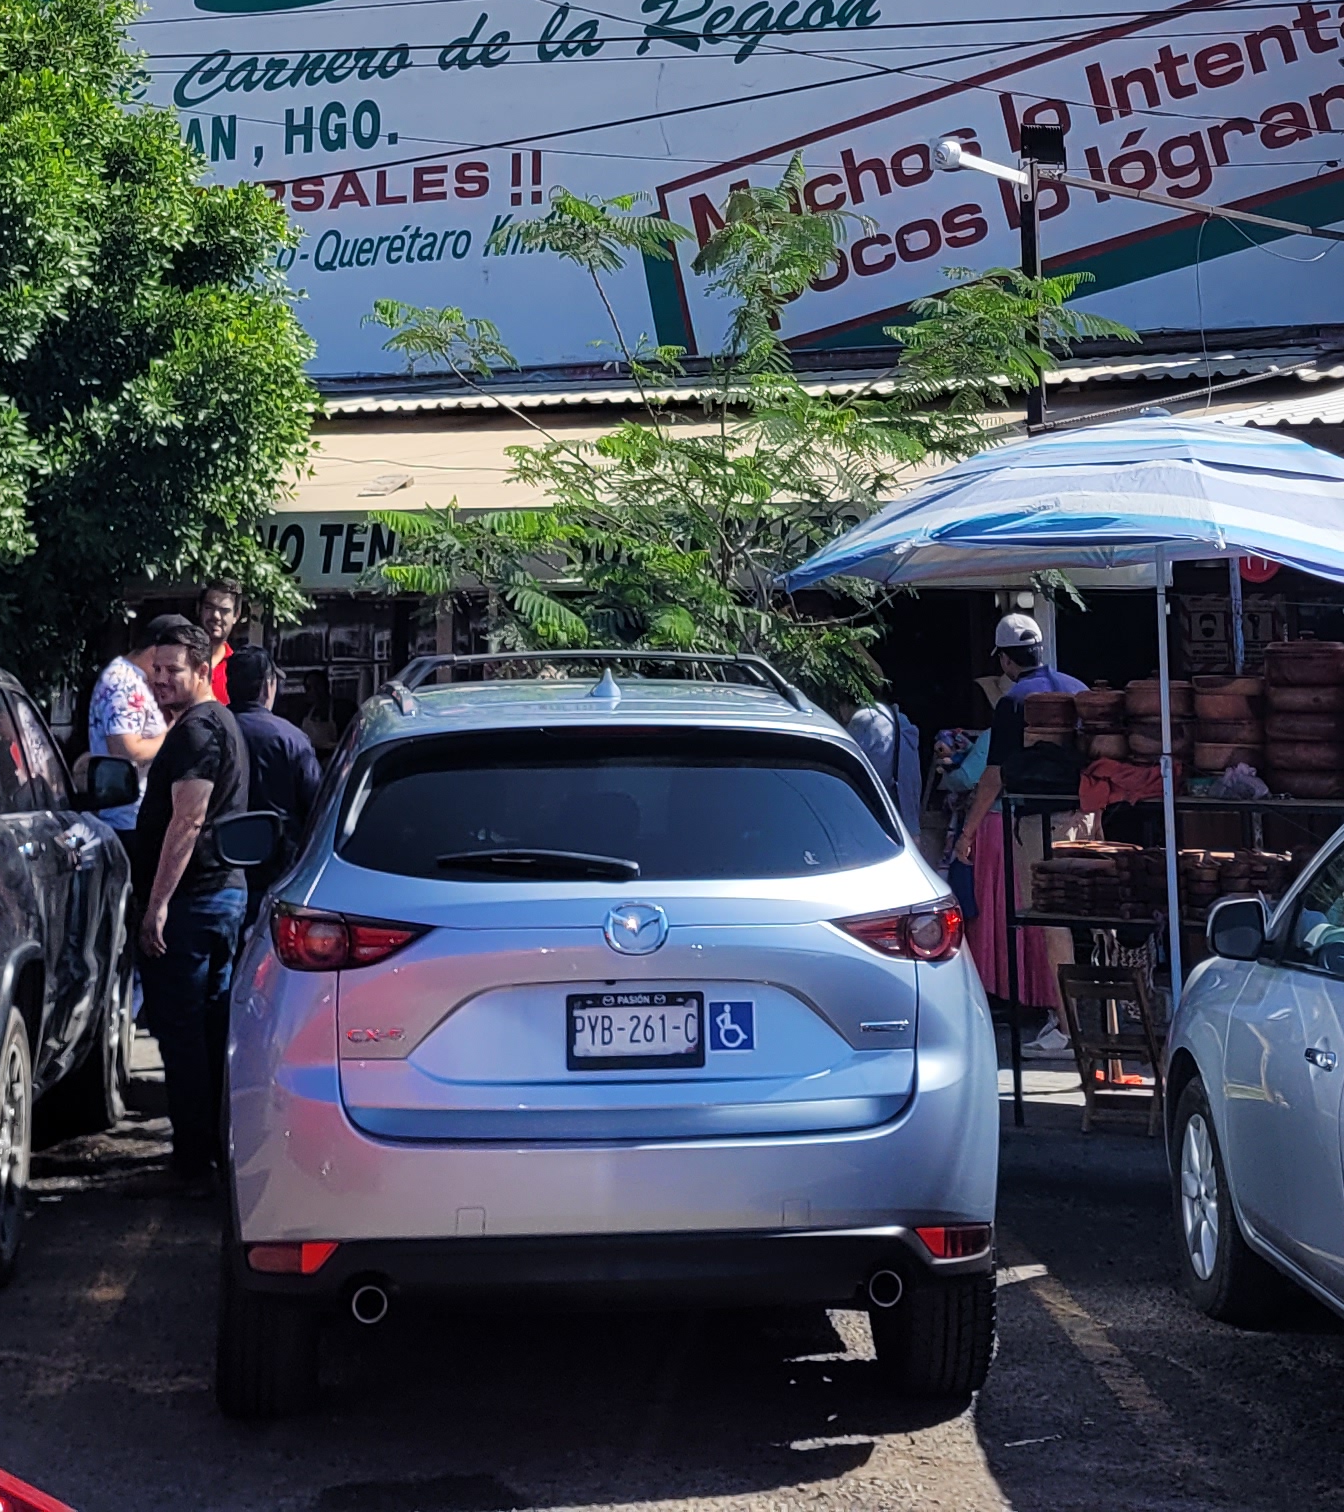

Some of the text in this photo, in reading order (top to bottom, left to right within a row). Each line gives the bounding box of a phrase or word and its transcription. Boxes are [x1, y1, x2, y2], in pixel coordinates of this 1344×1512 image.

[173, 41, 412, 107] Carnero
[438, 13, 511, 69] de
[538, 1, 605, 61] la
[284, 101, 399, 155] HGO.
[689, 127, 983, 253] Mchos
[768, 203, 989, 331] ocos
[256, 524, 305, 575] NO
[617, 994, 650, 1005] PASIÓN
[346, 1028, 406, 1042] CX-5
[574, 1013, 697, 1046] PYB-261-C
